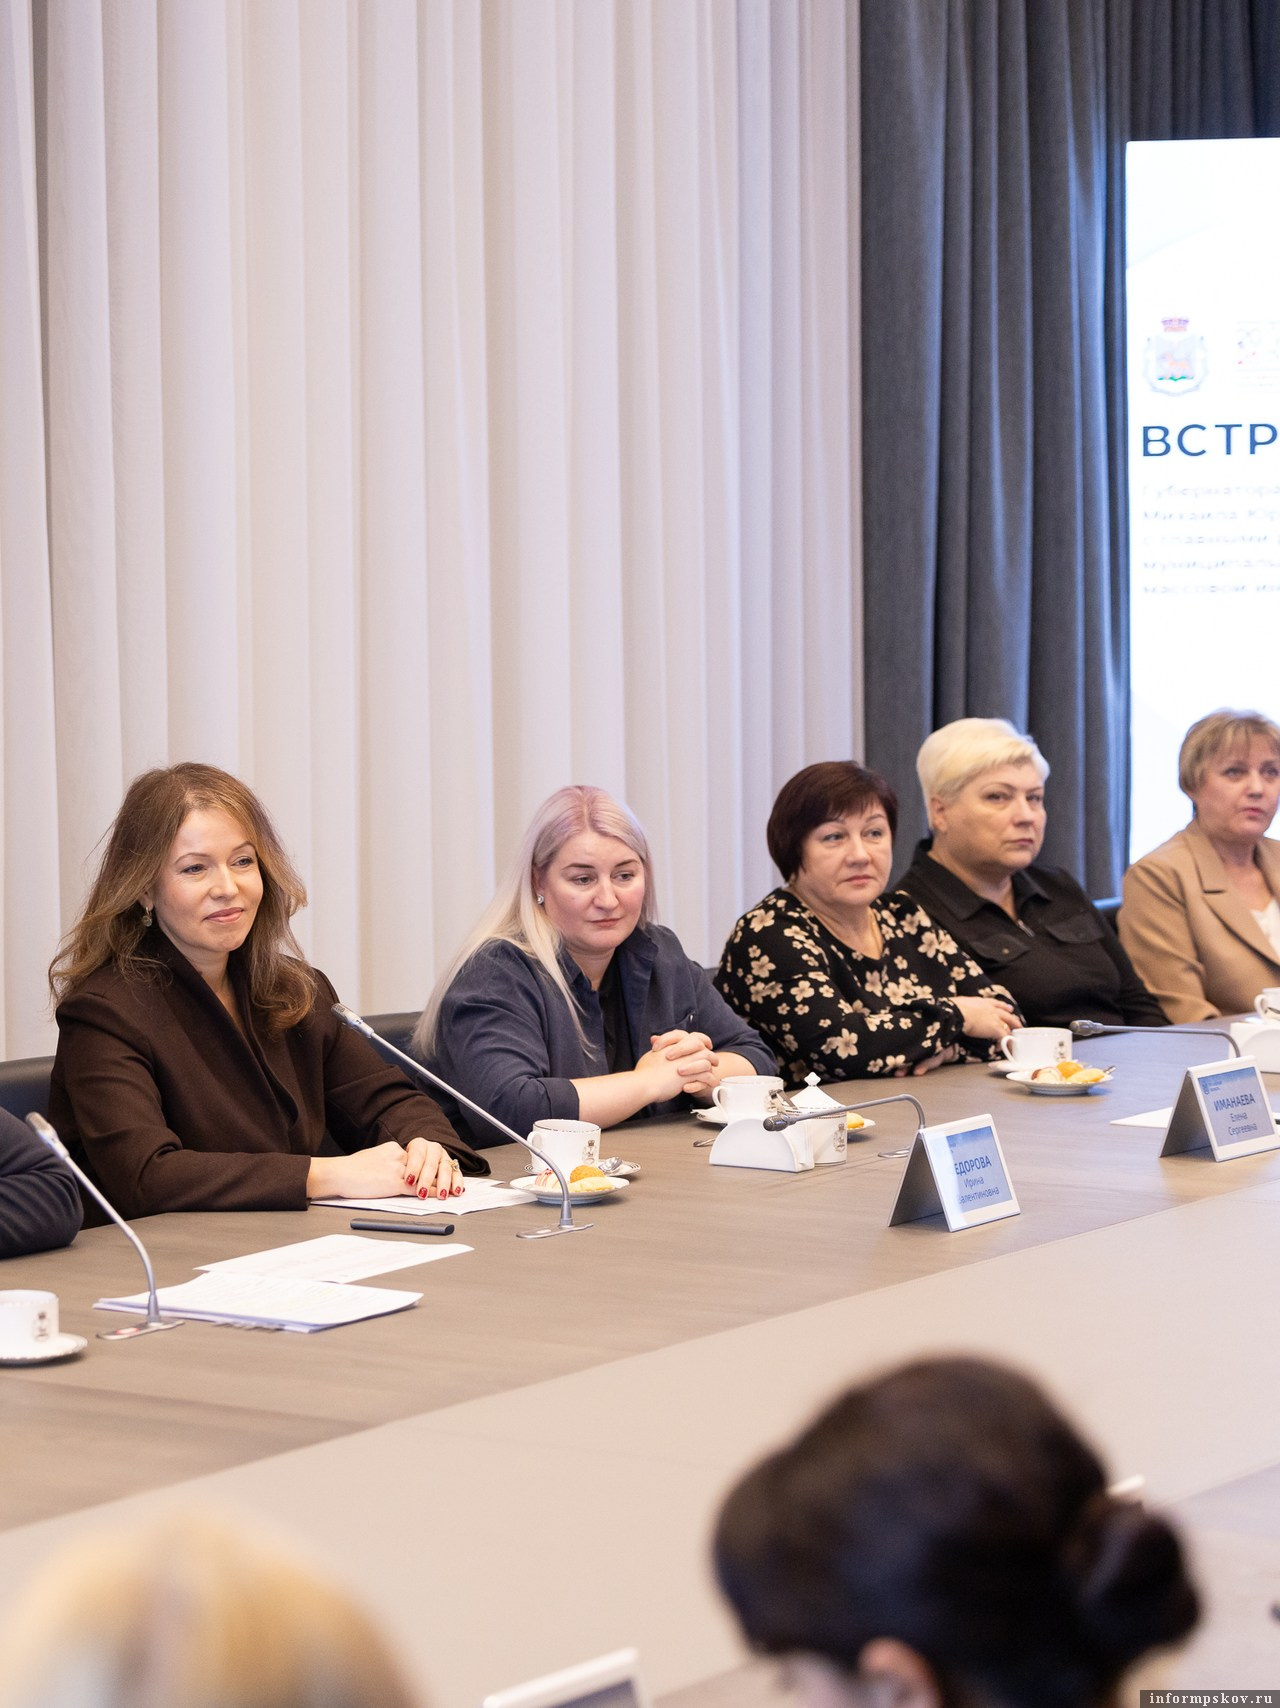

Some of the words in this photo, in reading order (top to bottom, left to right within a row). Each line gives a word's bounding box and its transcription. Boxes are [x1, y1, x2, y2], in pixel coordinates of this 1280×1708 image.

[1142, 423, 1278, 457] ВСТР
[1213, 1093, 1256, 1112] ИМАНАЕВА
[953, 1155, 993, 1177] ЕДОРОВА
[963, 1176, 985, 1190] Ирина
[959, 1186, 1000, 1205] алентиновна
